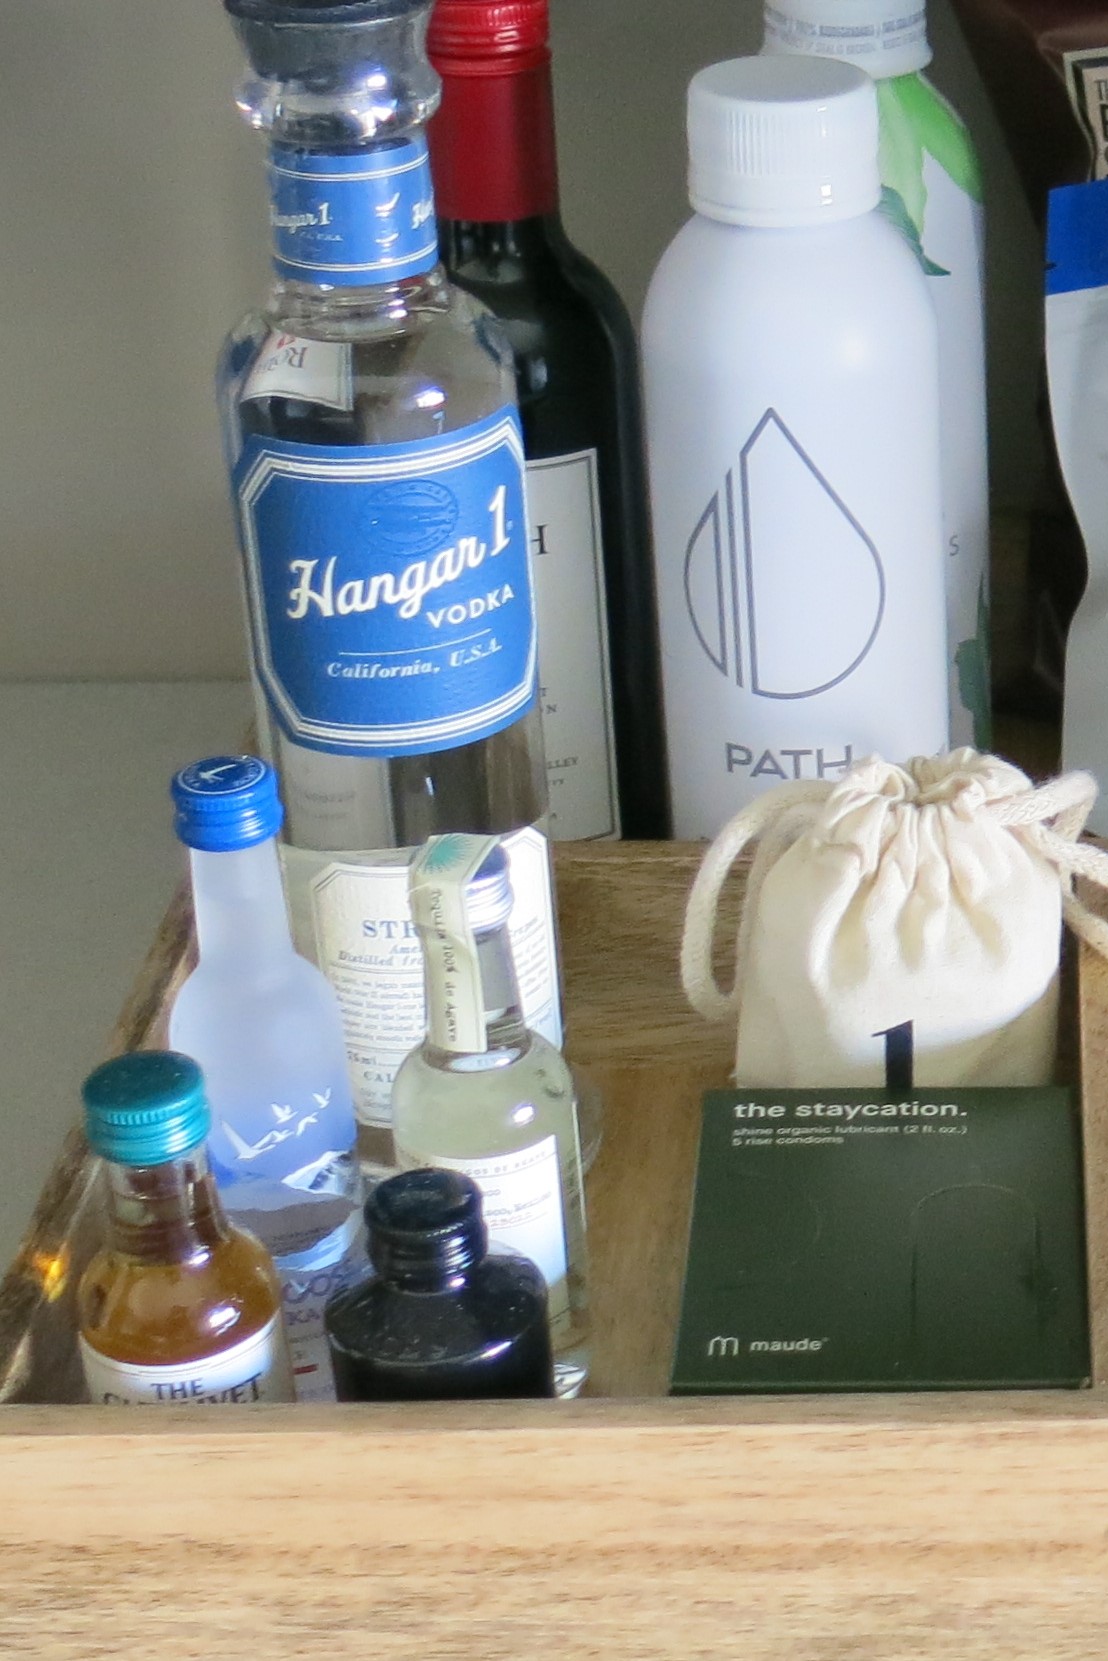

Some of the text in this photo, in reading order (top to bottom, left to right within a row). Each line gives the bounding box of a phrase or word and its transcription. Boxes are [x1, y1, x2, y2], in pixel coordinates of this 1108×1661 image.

[286, 535, 487, 619] Hangar
[488, 485, 511, 558] 1
[426, 584, 516, 629] VODKA
[327, 658, 440, 679] California,
[725, 742, 852, 780] PATH
[871, 1020, 913, 1090] 1
[734, 1101, 968, 1120] the staycation.
[733, 1126, 774, 1136] shine
[776, 1125, 832, 1137] organic
[835, 1124, 899, 1134] lubricant
[745, 1136, 772, 1145] rise
[776, 1135, 845, 1145] condoms
[750, 1338, 823, 1352] maude
[151, 1378, 205, 1400] THE
